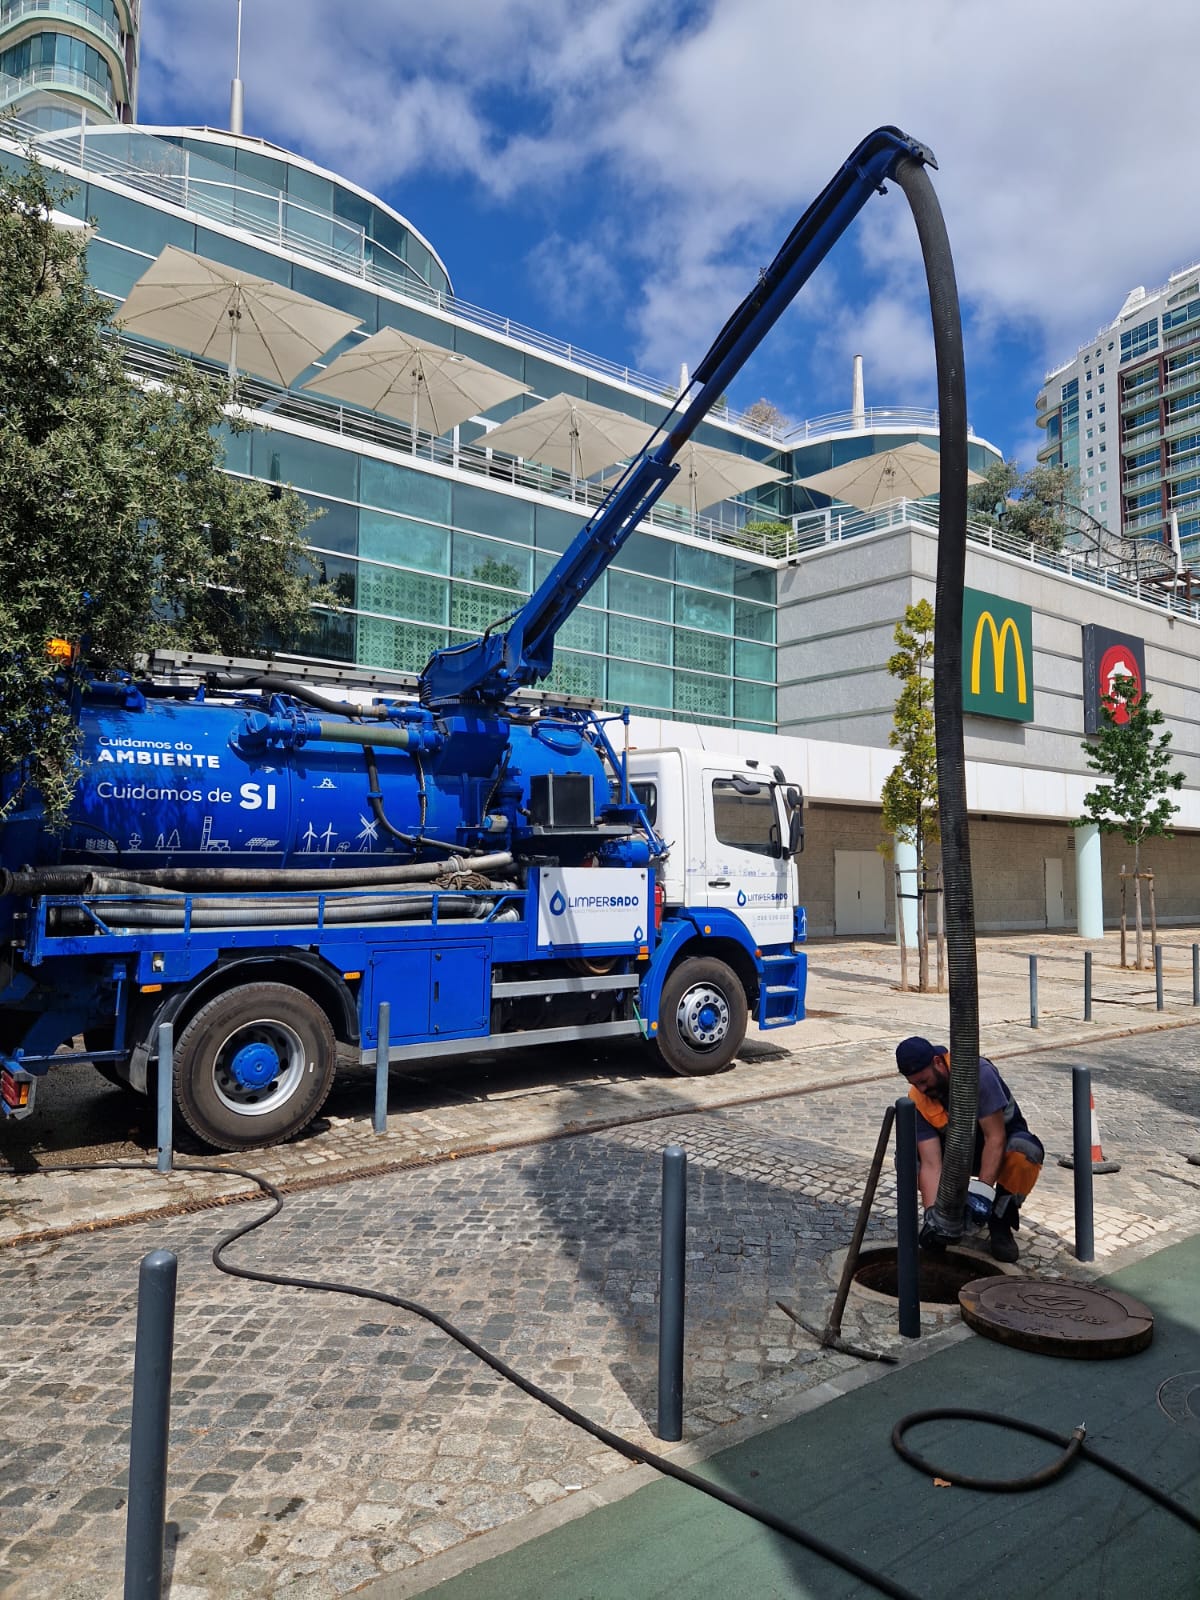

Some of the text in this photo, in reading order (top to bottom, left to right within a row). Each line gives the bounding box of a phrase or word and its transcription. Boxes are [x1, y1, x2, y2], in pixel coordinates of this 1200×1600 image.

[98, 736, 193, 751] Cuidamos do
[97, 749, 221, 769] AMBIENTE
[97, 782, 277, 811] Cuidamos de SI
[568, 896, 640, 908] LIMPERSADO
